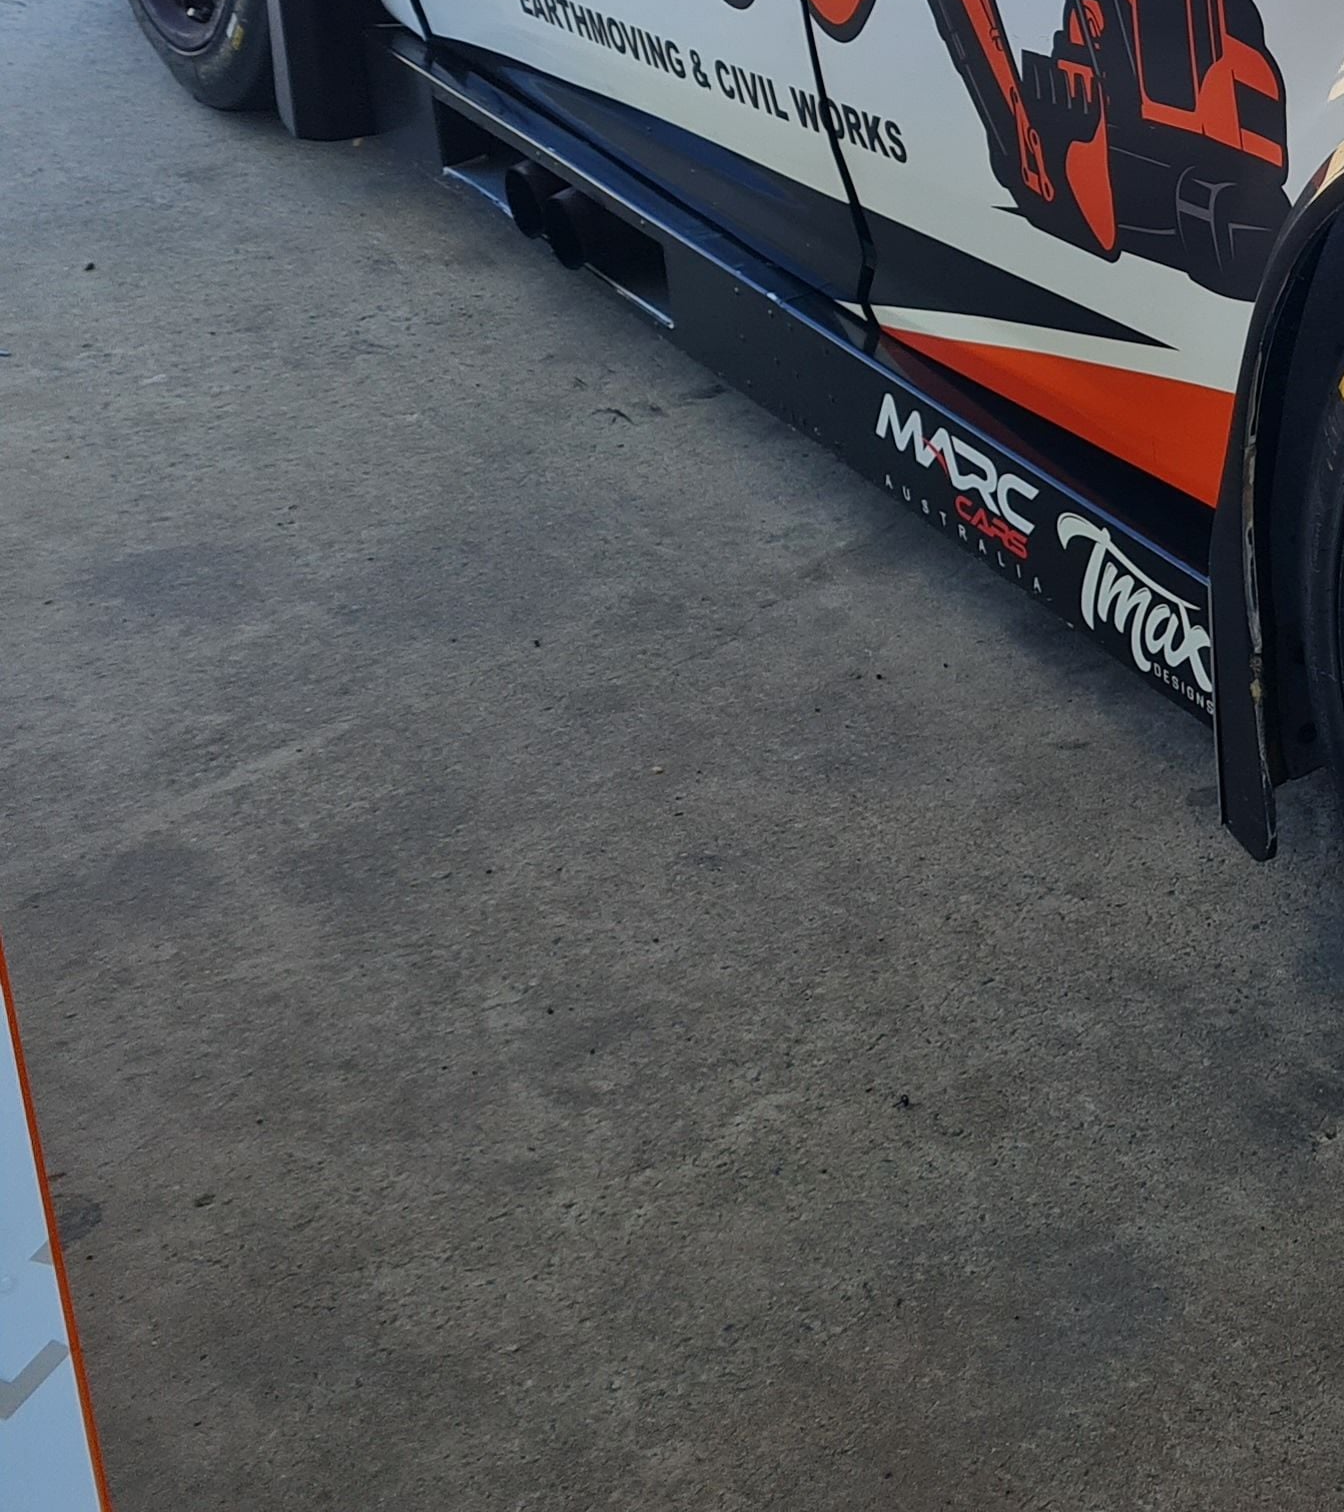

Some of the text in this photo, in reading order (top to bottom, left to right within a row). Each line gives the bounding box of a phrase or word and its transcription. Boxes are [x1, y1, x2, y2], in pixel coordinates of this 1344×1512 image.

[691, 49, 709, 92] &
[718, 59, 789, 122] CIVIL
[793, 84, 908, 164] WORKS
[873, 391, 1041, 537] MARC
[884, 472, 1044, 595] AUSTRALIA
[954, 494, 1030, 560] CARS
